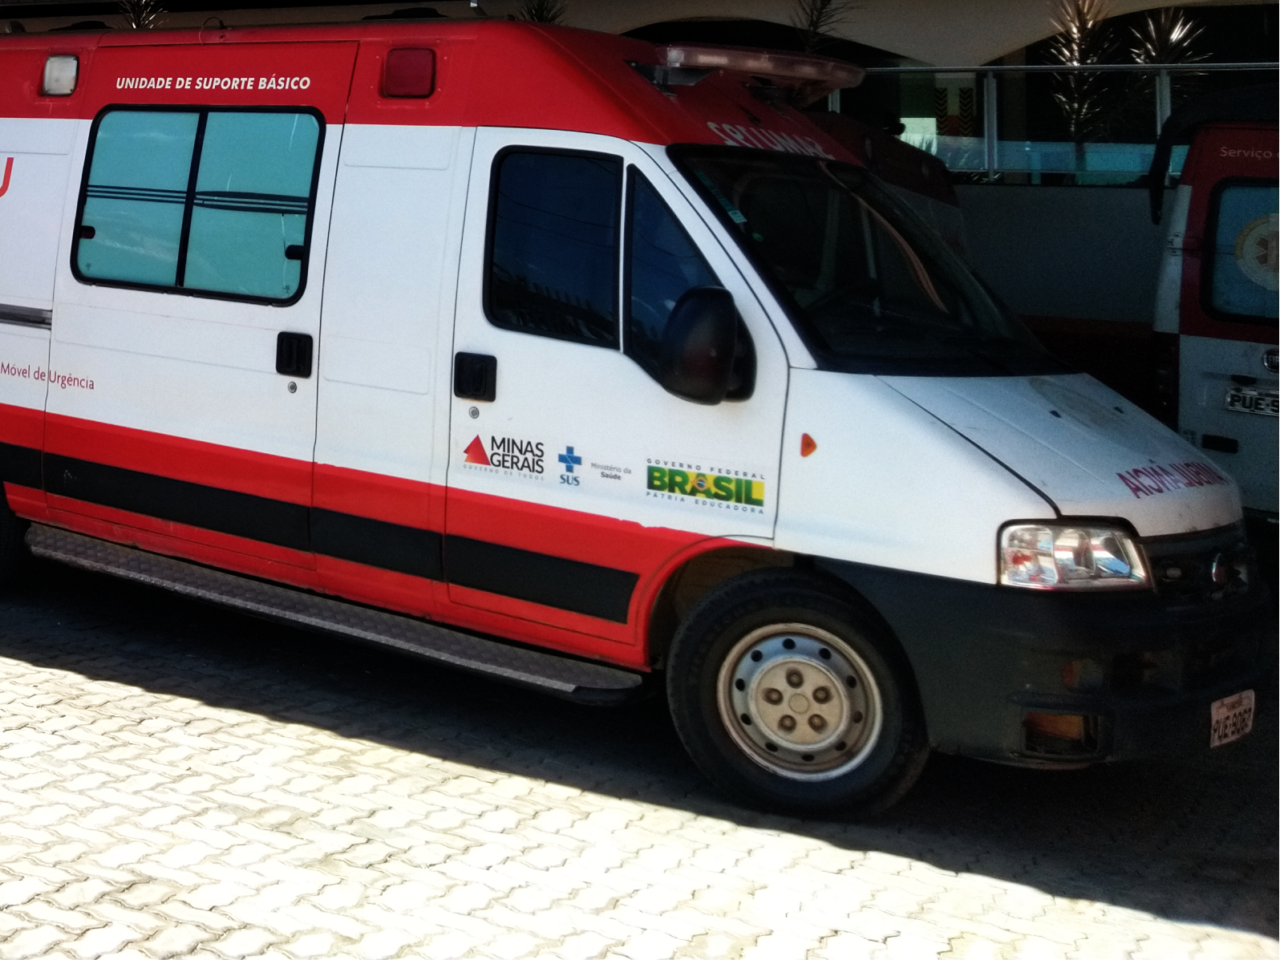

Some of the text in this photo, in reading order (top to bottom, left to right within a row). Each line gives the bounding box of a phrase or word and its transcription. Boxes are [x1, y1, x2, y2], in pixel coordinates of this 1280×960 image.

[116, 73, 311, 90] UNIDADE DE SUPORTE BÁSICO
[1220, 147, 1273, 160] Serviço
[0, 362, 31, 379] Móvel
[33, 367, 46, 381] de
[48, 370, 95, 390] Urgência
[491, 435, 544, 458] MINAS
[463, 464, 499, 474] GOVERNO
[490, 452, 544, 474] GERAIS
[591, 462, 622, 473] Ministério
[646, 458, 765, 480] GOVERNO FEDERAL
[559, 474, 580, 486] SUS
[600, 471, 622, 480] Saúde
[647, 465, 765, 507] BRASIL
[694, 499, 764, 514] EDUCADORA
